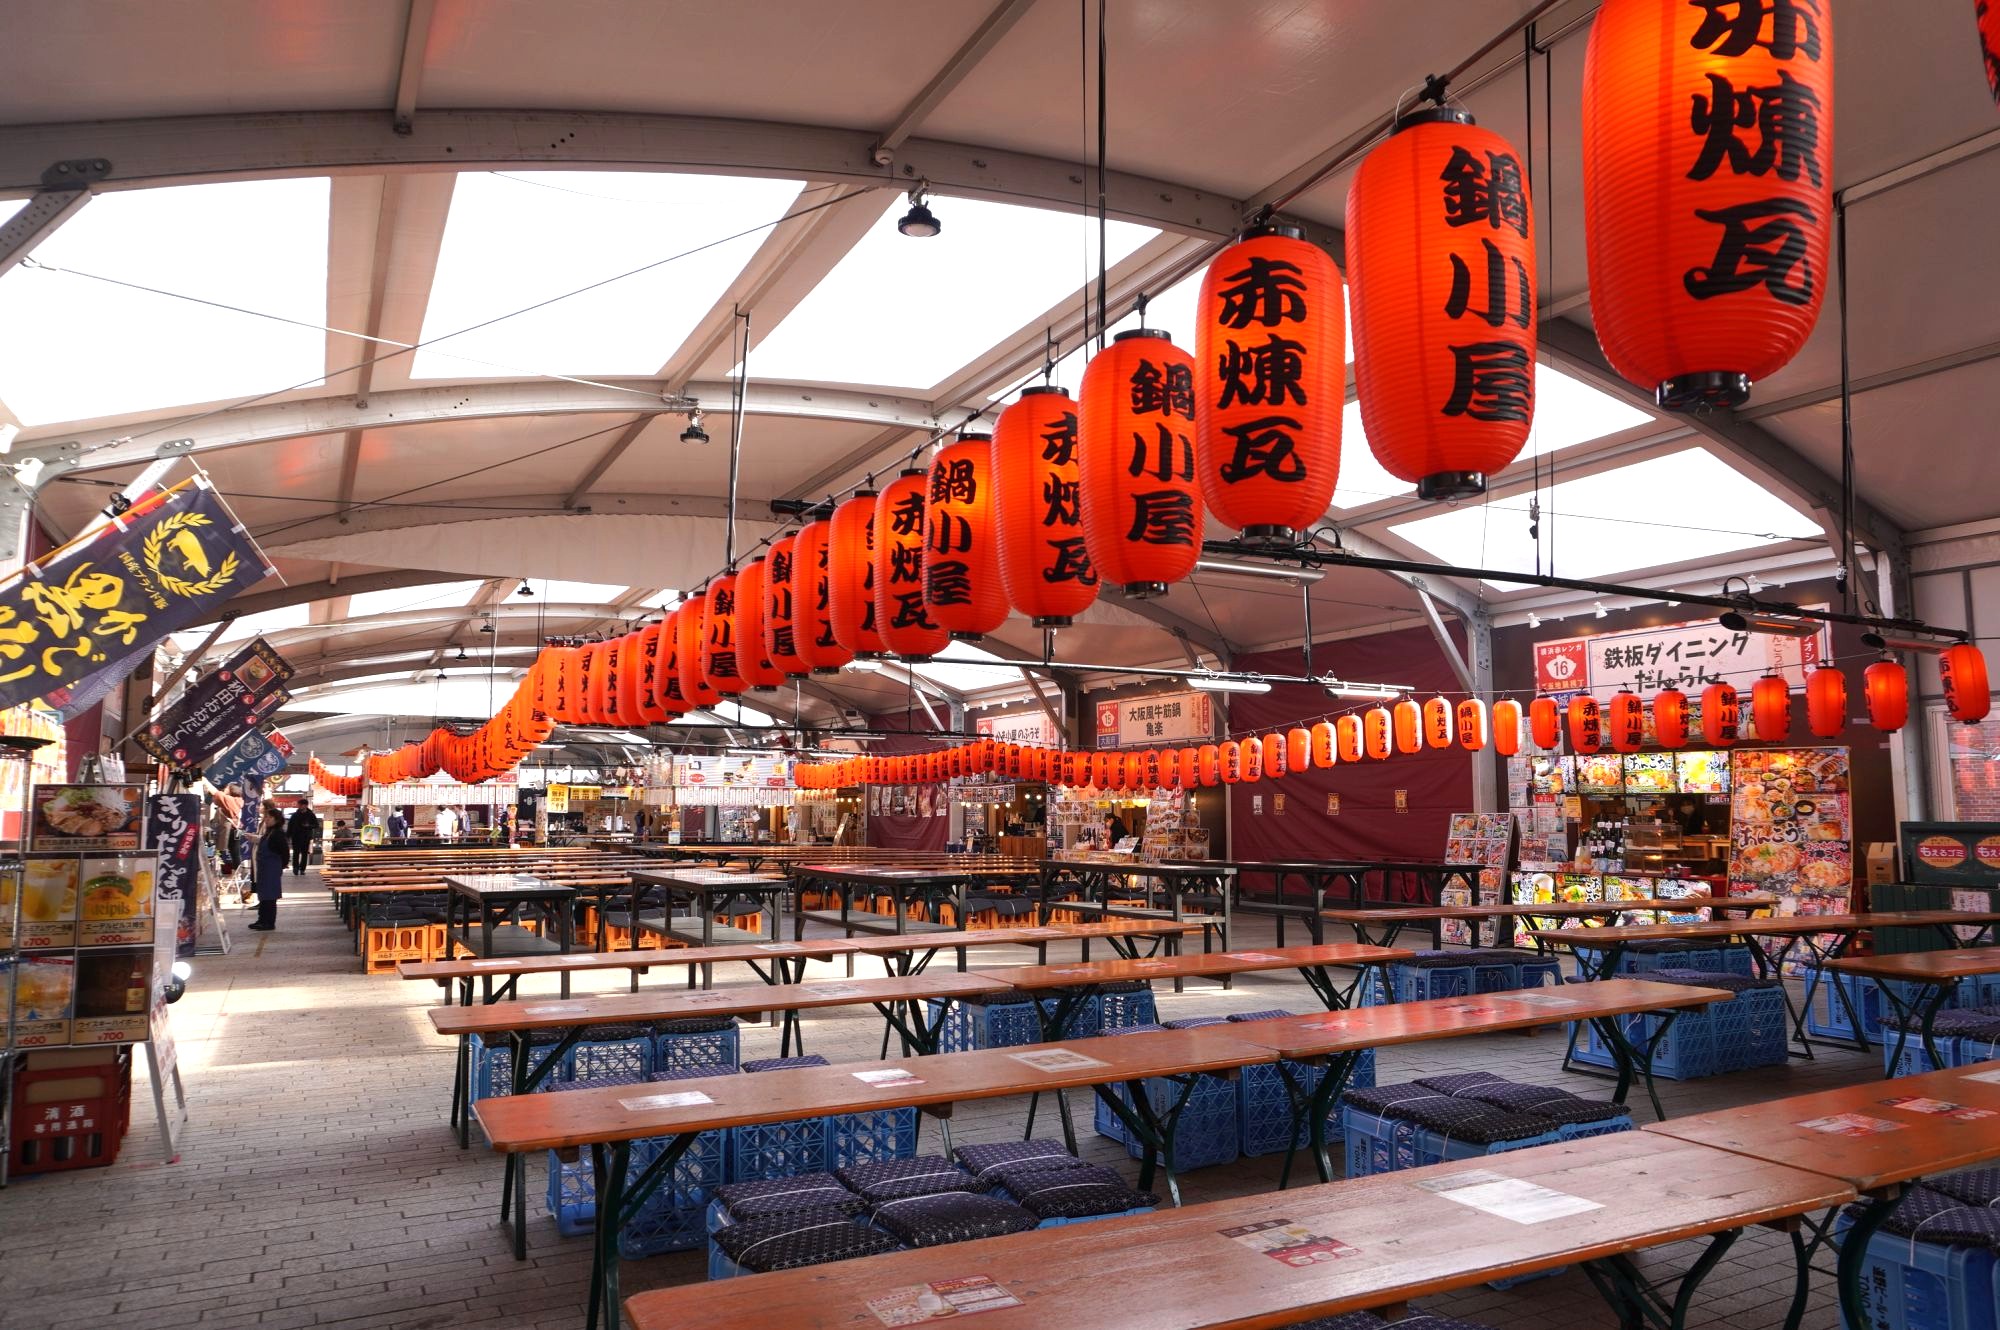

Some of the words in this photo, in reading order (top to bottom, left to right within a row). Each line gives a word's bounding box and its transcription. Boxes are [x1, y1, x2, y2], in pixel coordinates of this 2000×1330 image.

[1439, 145, 1531, 425] 鍋小屋
[1217, 257, 1307, 485] 赤煉瓦
[1126, 358, 1195, 547] 鍋小屋
[926, 459, 976, 607] 鍋小屋
[1554, 661, 1569, 676] 16
[1604, 632, 1750, 669] 鉄板ダイニング
[1634, 666, 1719, 693] だんらん
[1104, 714, 1112, 725] 15
[1129, 702, 1181, 722] 大阪風牛筋鍋
[1460, 707, 1474, 744] 鍋小屋
[1582, 701, 1600, 746] 赤煉瓦
[1626, 699, 1642, 746] 鍋小屋
[1719, 691, 1738, 740] 鍋小屋
[1920, 846, 1965, 857] もえるゴミ
[1978, 846, 2000, 857] もえ
[44, 1104, 87, 1121] 清酒
